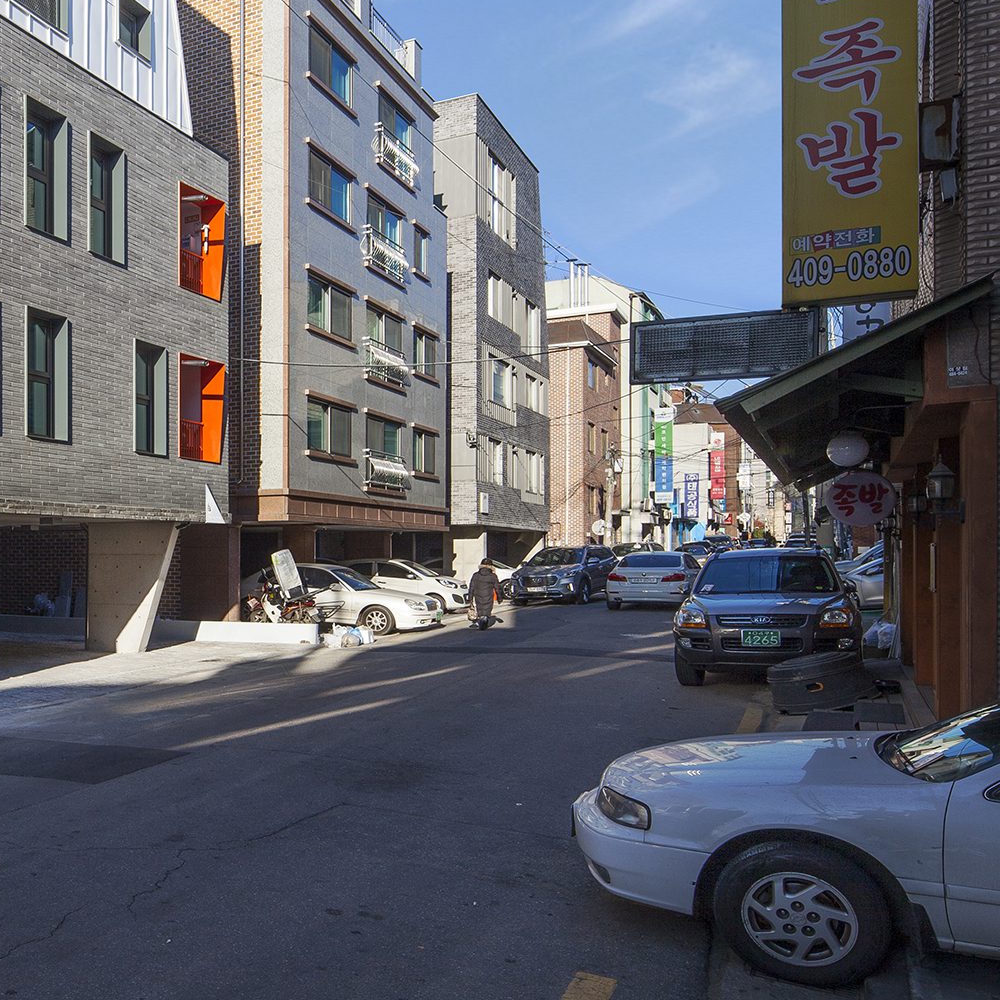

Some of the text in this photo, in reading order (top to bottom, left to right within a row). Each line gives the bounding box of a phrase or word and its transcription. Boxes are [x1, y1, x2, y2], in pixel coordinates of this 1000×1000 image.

[793, 18, 901, 197] 족발
[792, 227, 876, 252] 예약전화
[787, 245, 911, 288] 409-0880
[832, 482, 890, 517] 족발
[744, 635, 778, 645] 4265
